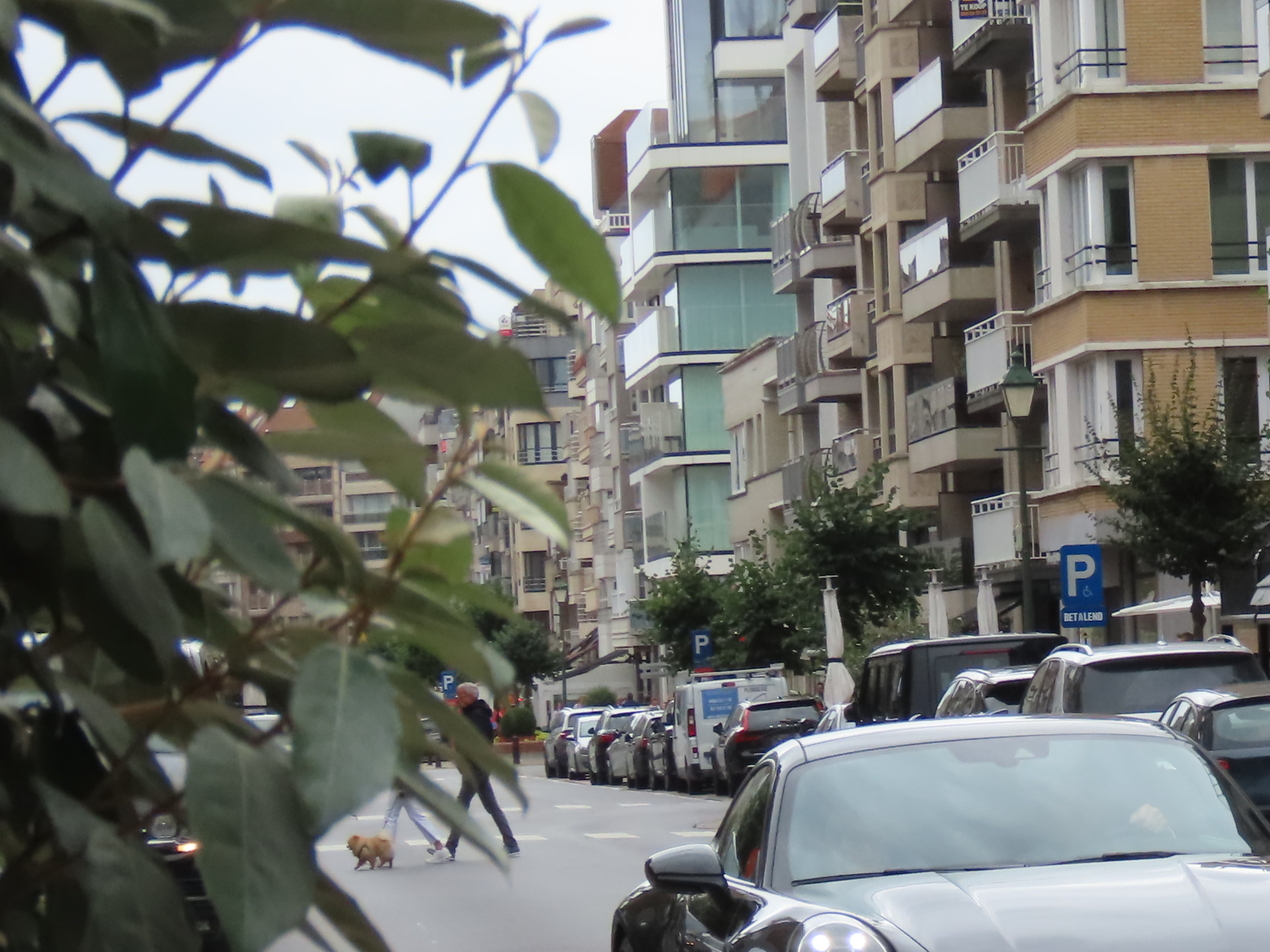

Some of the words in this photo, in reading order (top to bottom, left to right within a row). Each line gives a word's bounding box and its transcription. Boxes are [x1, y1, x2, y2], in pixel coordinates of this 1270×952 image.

[1066, 554, 1096, 597] P
[1063, 612, 1103, 622] BETALEND
[695, 635, 709, 654] P
[444, 676, 455, 691] P
